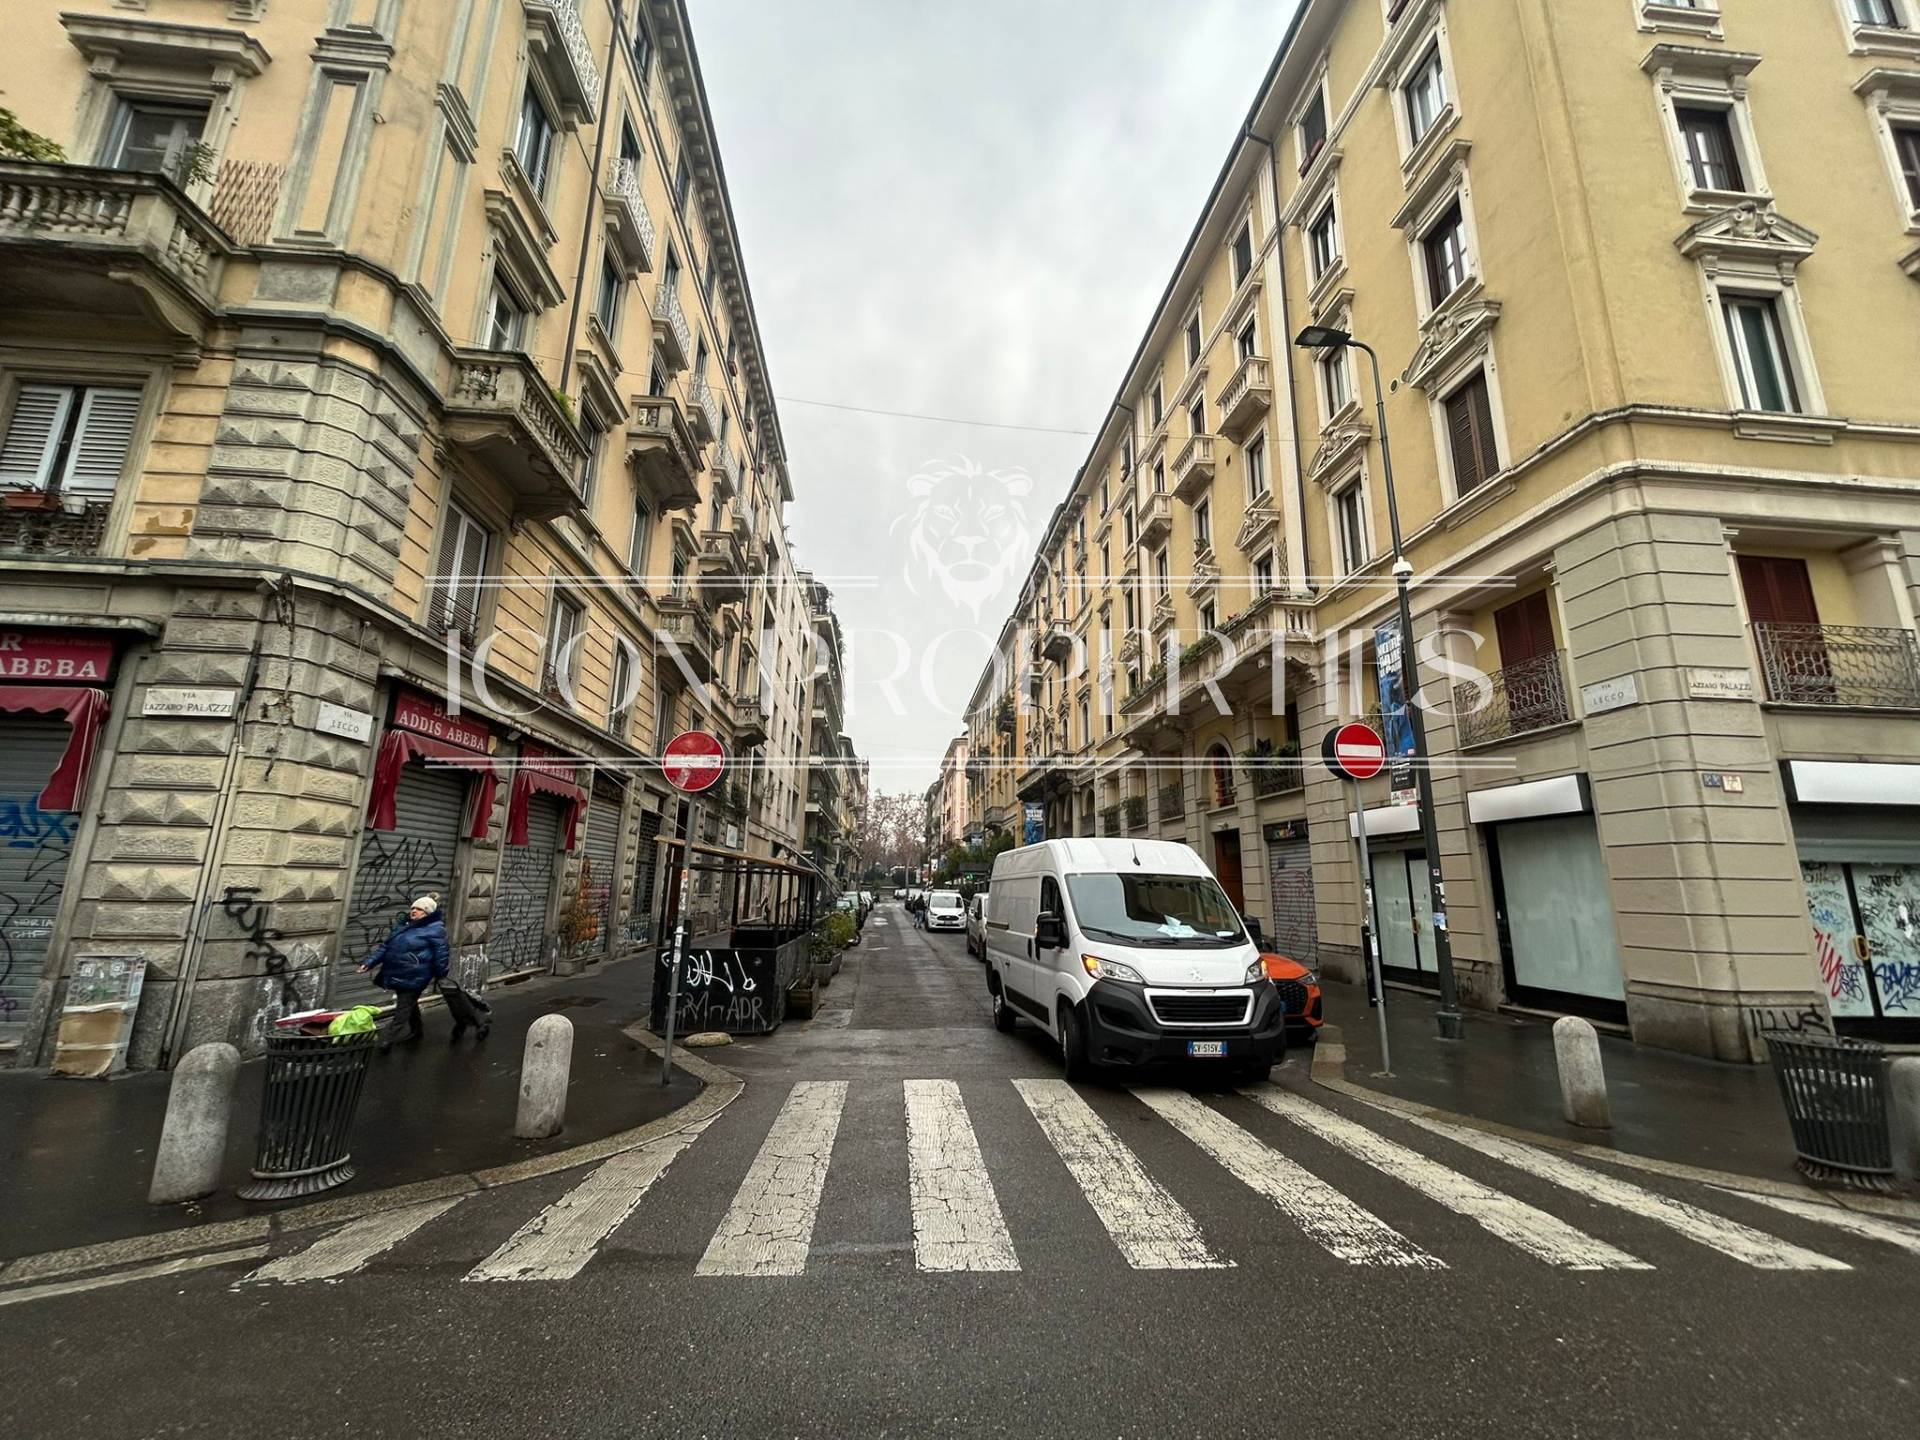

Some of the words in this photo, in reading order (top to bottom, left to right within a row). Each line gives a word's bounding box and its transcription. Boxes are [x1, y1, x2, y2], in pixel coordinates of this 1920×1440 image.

[1593, 691, 1624, 705] LECCO
[144, 703, 183, 711] LAZZARO
[187, 703, 232, 713] PALAZZI
[330, 720, 359, 733] LECCO
[399, 710, 442, 736] ADDIS
[446, 727, 485, 751] ABEBA
